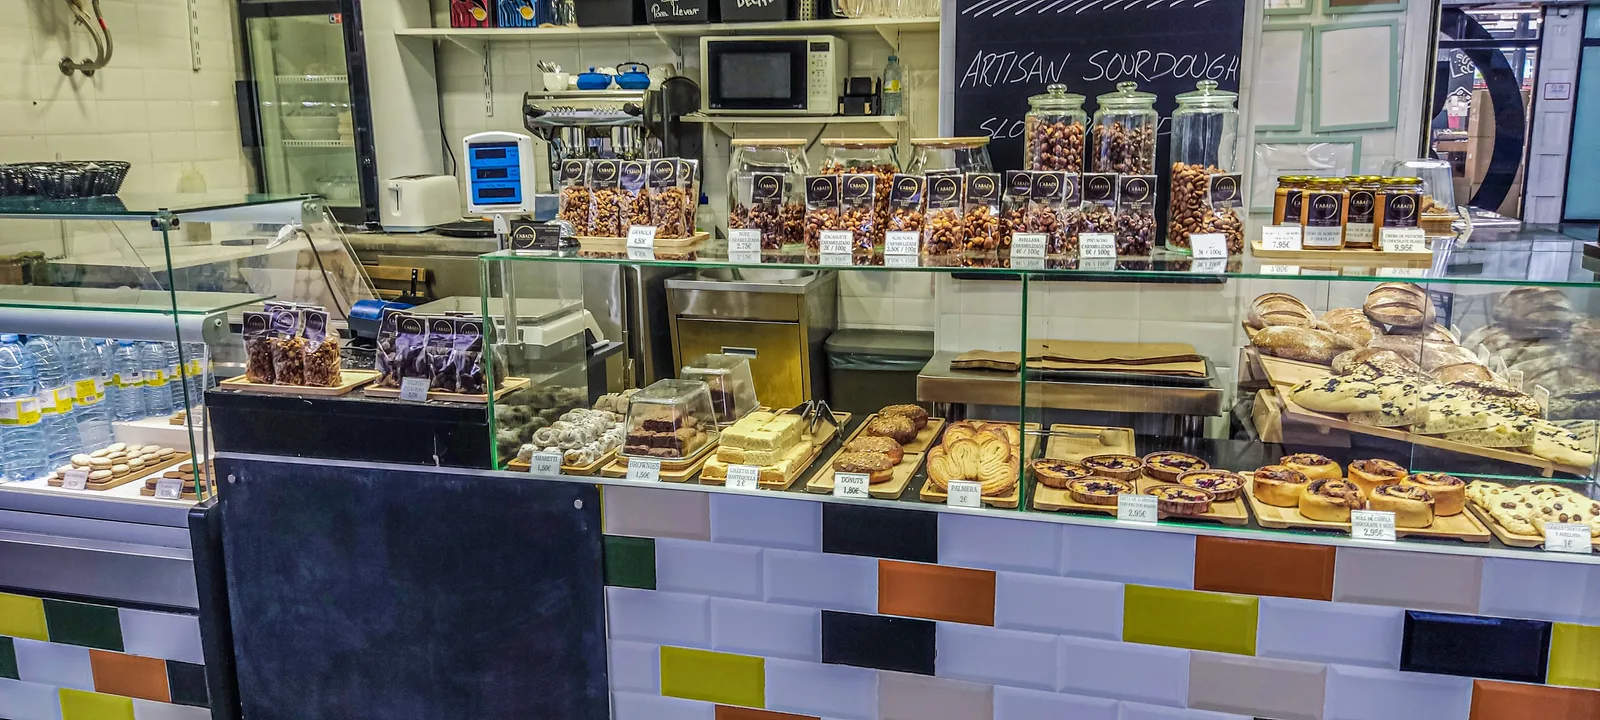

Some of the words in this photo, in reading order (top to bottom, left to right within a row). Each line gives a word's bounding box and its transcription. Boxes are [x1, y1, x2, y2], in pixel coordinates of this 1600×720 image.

[960, 50, 1071, 88] ARTISAN
[1082, 50, 1240, 82] SOURDOUGH
[629, 461, 660, 470] BROWNIES
[841, 476, 864, 484] DONUTS
[950, 485, 977, 493] PALMERA
